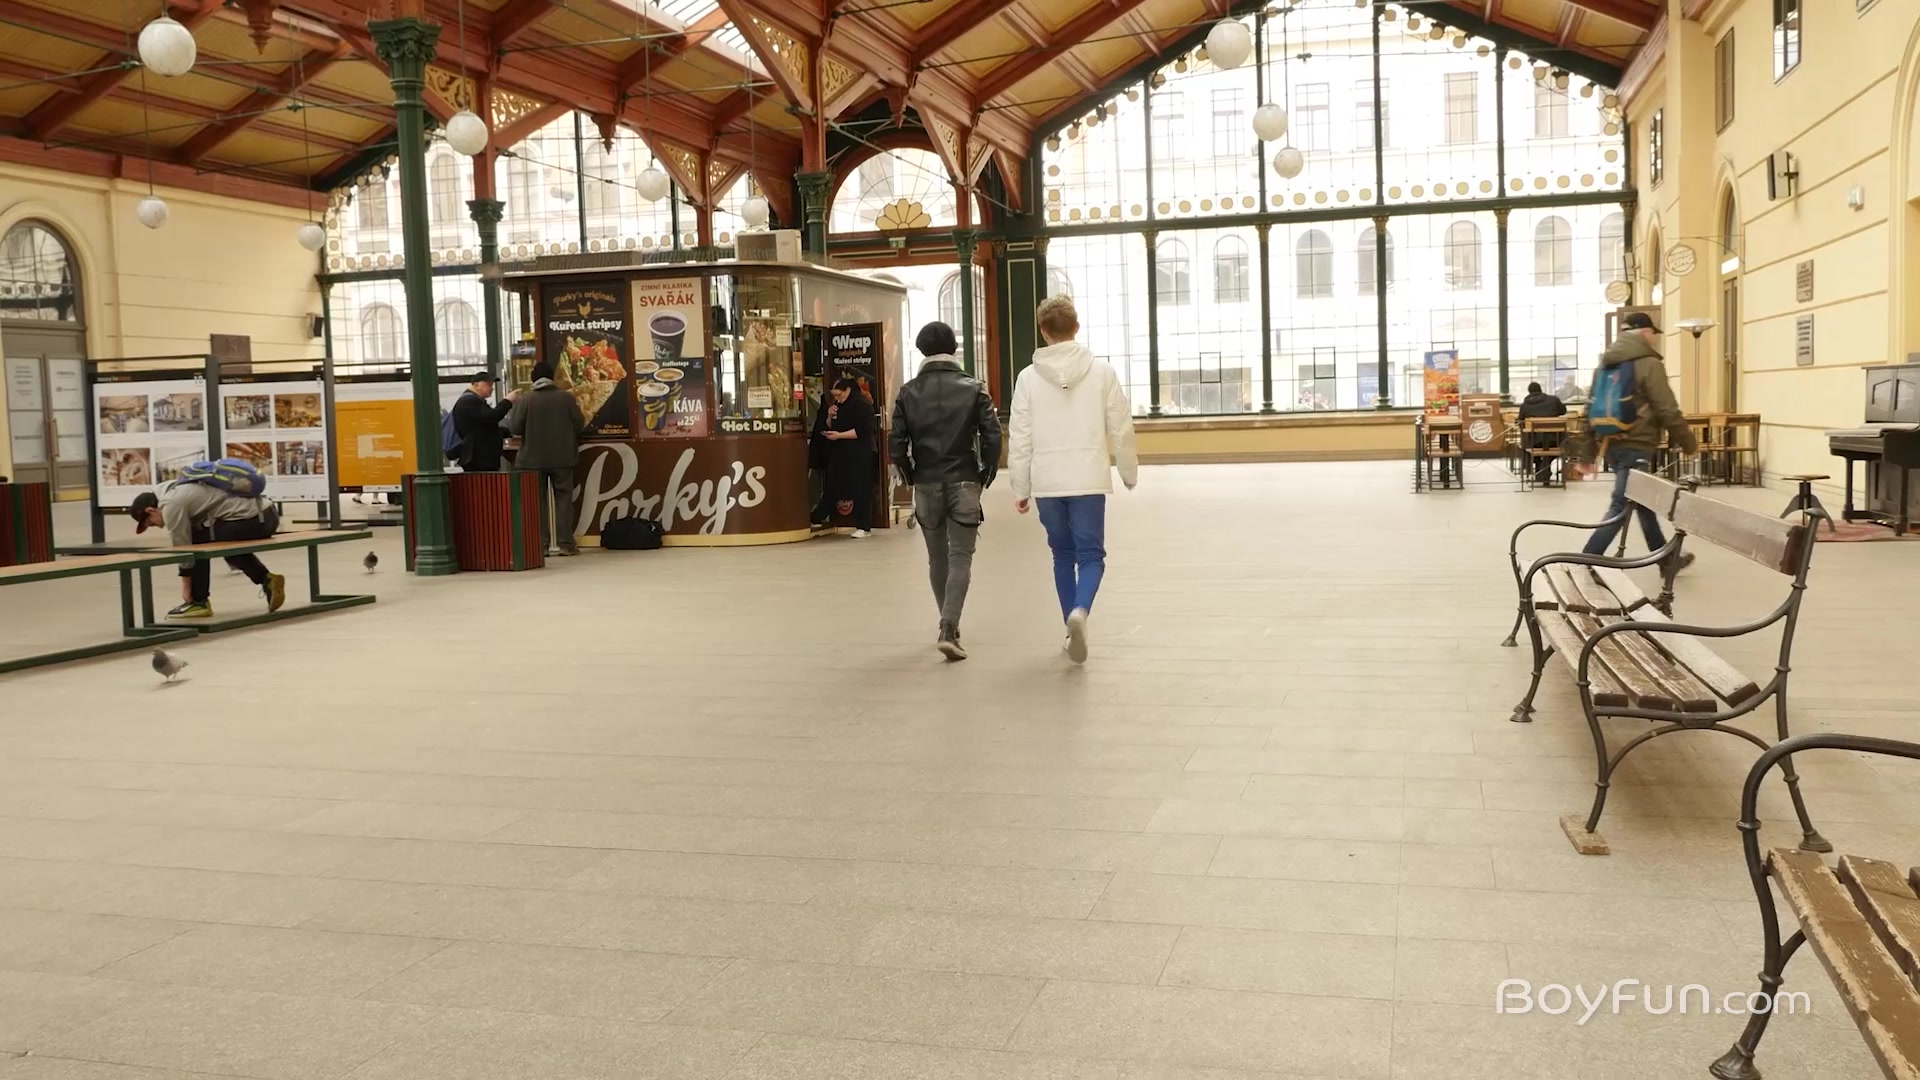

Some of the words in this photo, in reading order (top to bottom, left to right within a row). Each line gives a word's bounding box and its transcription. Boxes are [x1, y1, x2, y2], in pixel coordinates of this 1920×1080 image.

[641, 283, 661, 291] ZIMNÍ
[662, 282, 693, 290] KLASIKA
[552, 291, 583, 306] Parky's
[584, 290, 617, 304] originals
[640, 290, 695, 307] SVAŘÁK
[549, 320, 585, 331] Kuřecí
[586, 318, 622, 331] stripsy
[832, 334, 872, 354] Wrap
[853, 356, 872, 365] stripsy
[673, 397, 703, 413] KÁVA
[721, 421, 750, 432] Hot
[753, 420, 777, 433] Dog
[573, 443, 766, 535] Parky's
